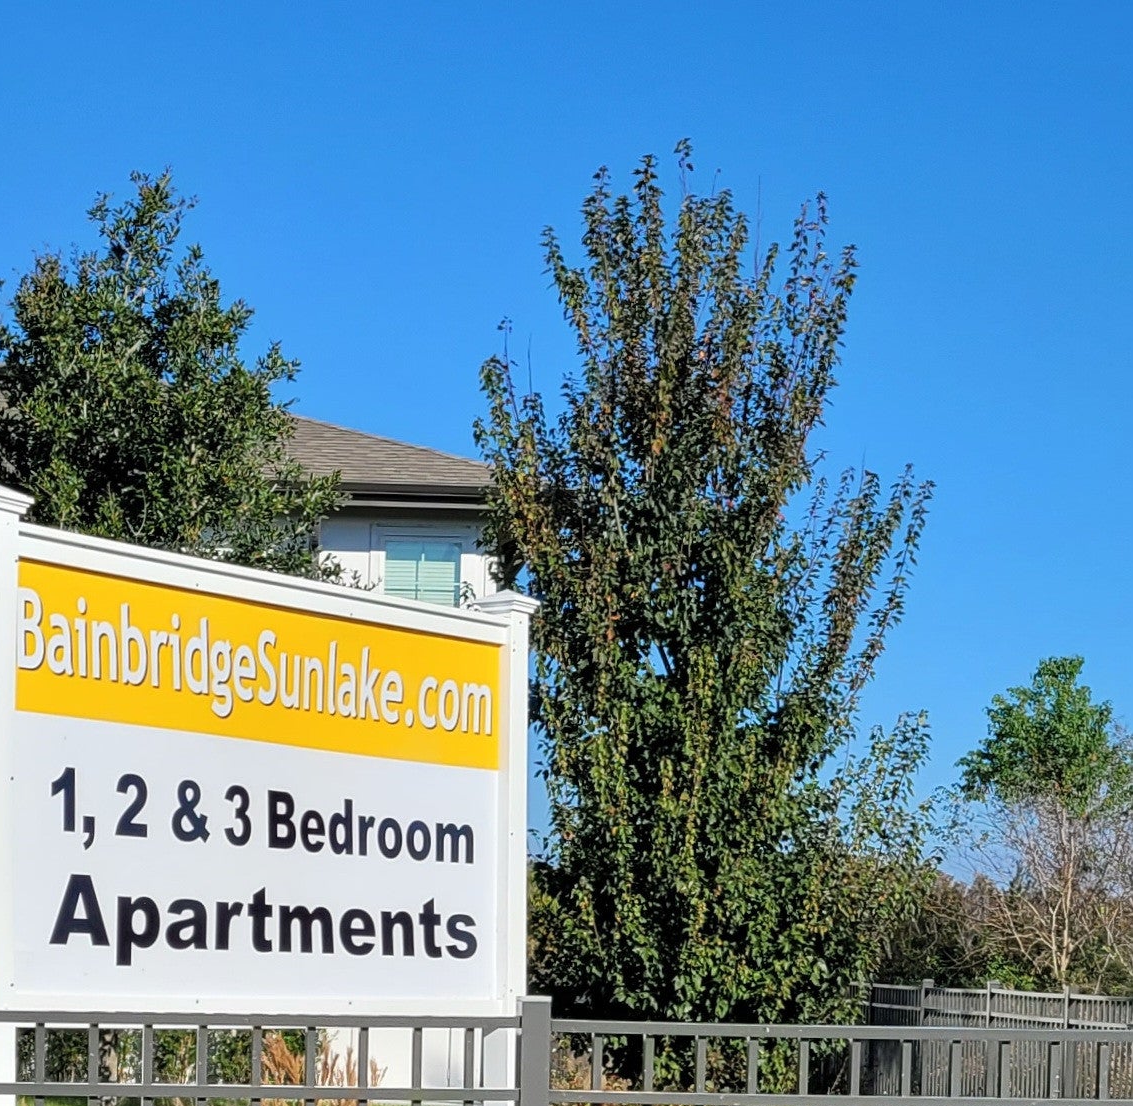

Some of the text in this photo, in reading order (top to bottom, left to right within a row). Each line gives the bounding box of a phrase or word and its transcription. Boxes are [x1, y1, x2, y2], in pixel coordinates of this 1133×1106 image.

[16, 586, 493, 737] BainbridgeSunlake.com
[50, 766, 474, 863] 1, 2 & 3 Bedroom
[50, 874, 477, 965] Apartments
